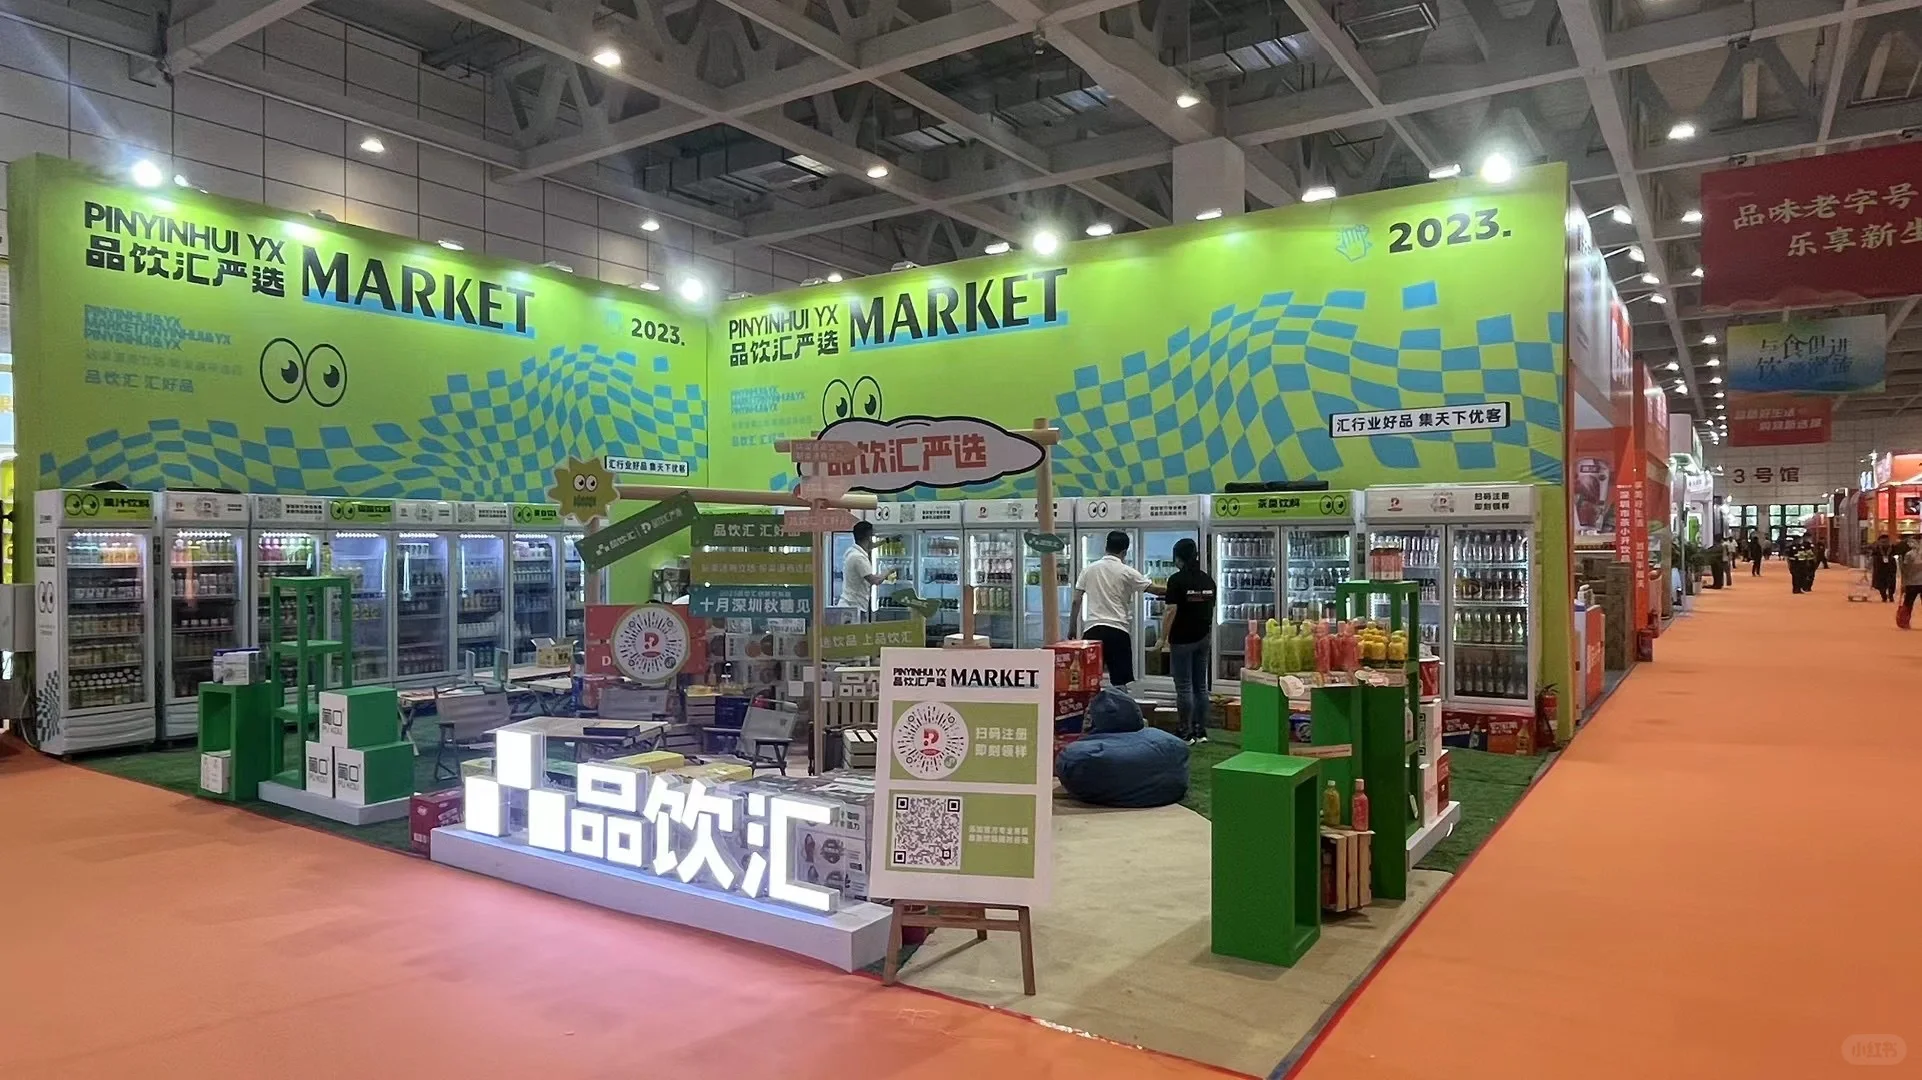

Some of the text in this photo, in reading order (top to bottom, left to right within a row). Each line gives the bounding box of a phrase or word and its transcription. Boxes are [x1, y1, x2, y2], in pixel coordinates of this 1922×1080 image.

[1733, 182, 1918, 230] 品味老字号
[84, 201, 287, 265] PINYINHUI YX
[1389, 208, 1511, 253] 2023.
[86, 235, 285, 297] 品饮汇严选
[302, 245, 535, 334] MARKET
[729, 304, 838, 340] PINYINHUI YX
[850, 268, 1067, 348] MARKET
[631, 318, 685, 346] 2023.
[730, 330, 839, 367] 品饮汇严选
[1337, 408, 1502, 433] 汇行业好品 集天下优客
[713, 523, 755, 537] 品饮汇
[862, 630, 913, 646] 上品饮汇
[893, 667, 947, 677] PINYINHUI YX
[951, 668, 1039, 688] MARKET
[975, 743, 1028, 758] 即刻领样
[976, 727, 1028, 741] 扫码注册
[571, 763, 840, 914] 品饮汇
